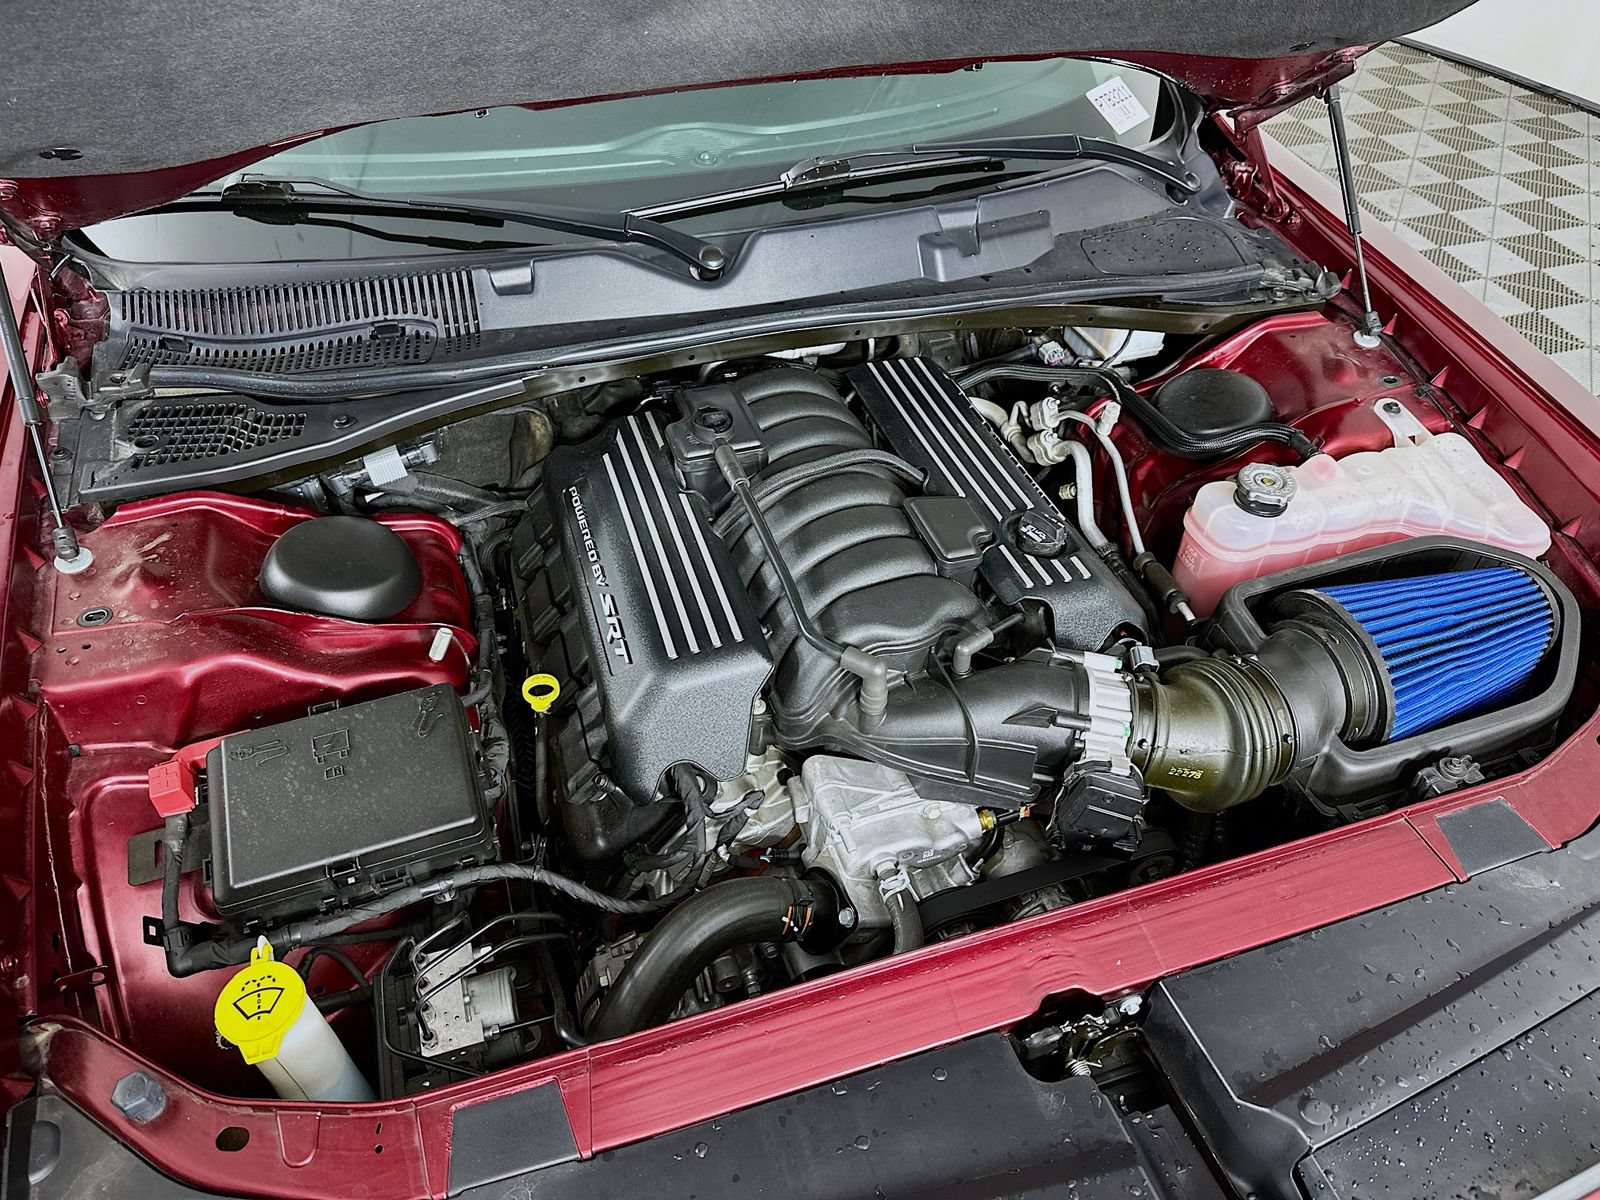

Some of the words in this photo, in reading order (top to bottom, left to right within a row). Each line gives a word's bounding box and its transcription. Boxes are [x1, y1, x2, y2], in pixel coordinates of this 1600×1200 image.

[568, 486, 600, 562] POWERED
[591, 564, 609, 588] BY
[599, 593, 633, 665] SRT
